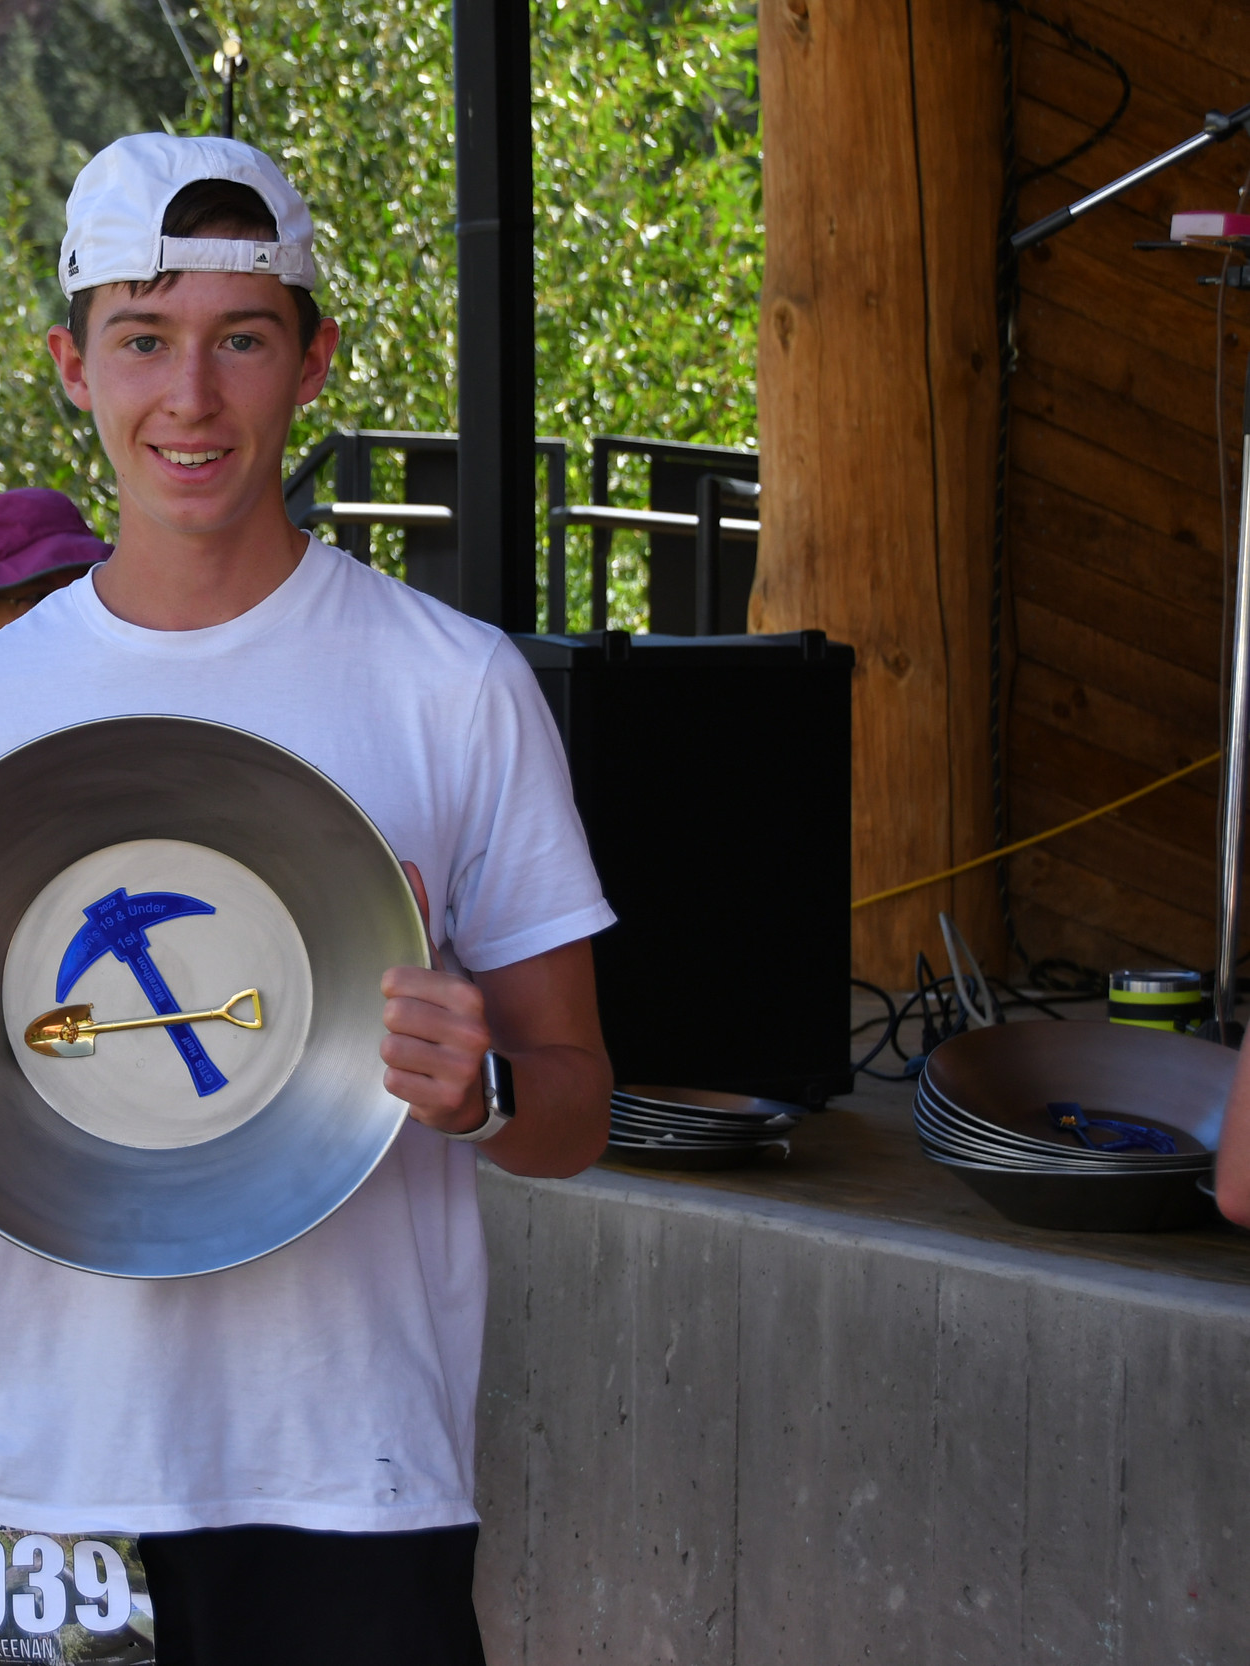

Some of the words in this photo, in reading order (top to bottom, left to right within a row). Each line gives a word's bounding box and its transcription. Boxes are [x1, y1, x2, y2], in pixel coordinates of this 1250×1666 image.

[98, 898, 117, 914] 2022
[100, 916, 114, 930] 19
[116, 911, 126, 921] &
[128, 902, 166, 916] Under
[117, 931, 138, 949] 1st
[136, 956, 166, 1003] Marathon
[181, 1036, 199, 1058] Half
